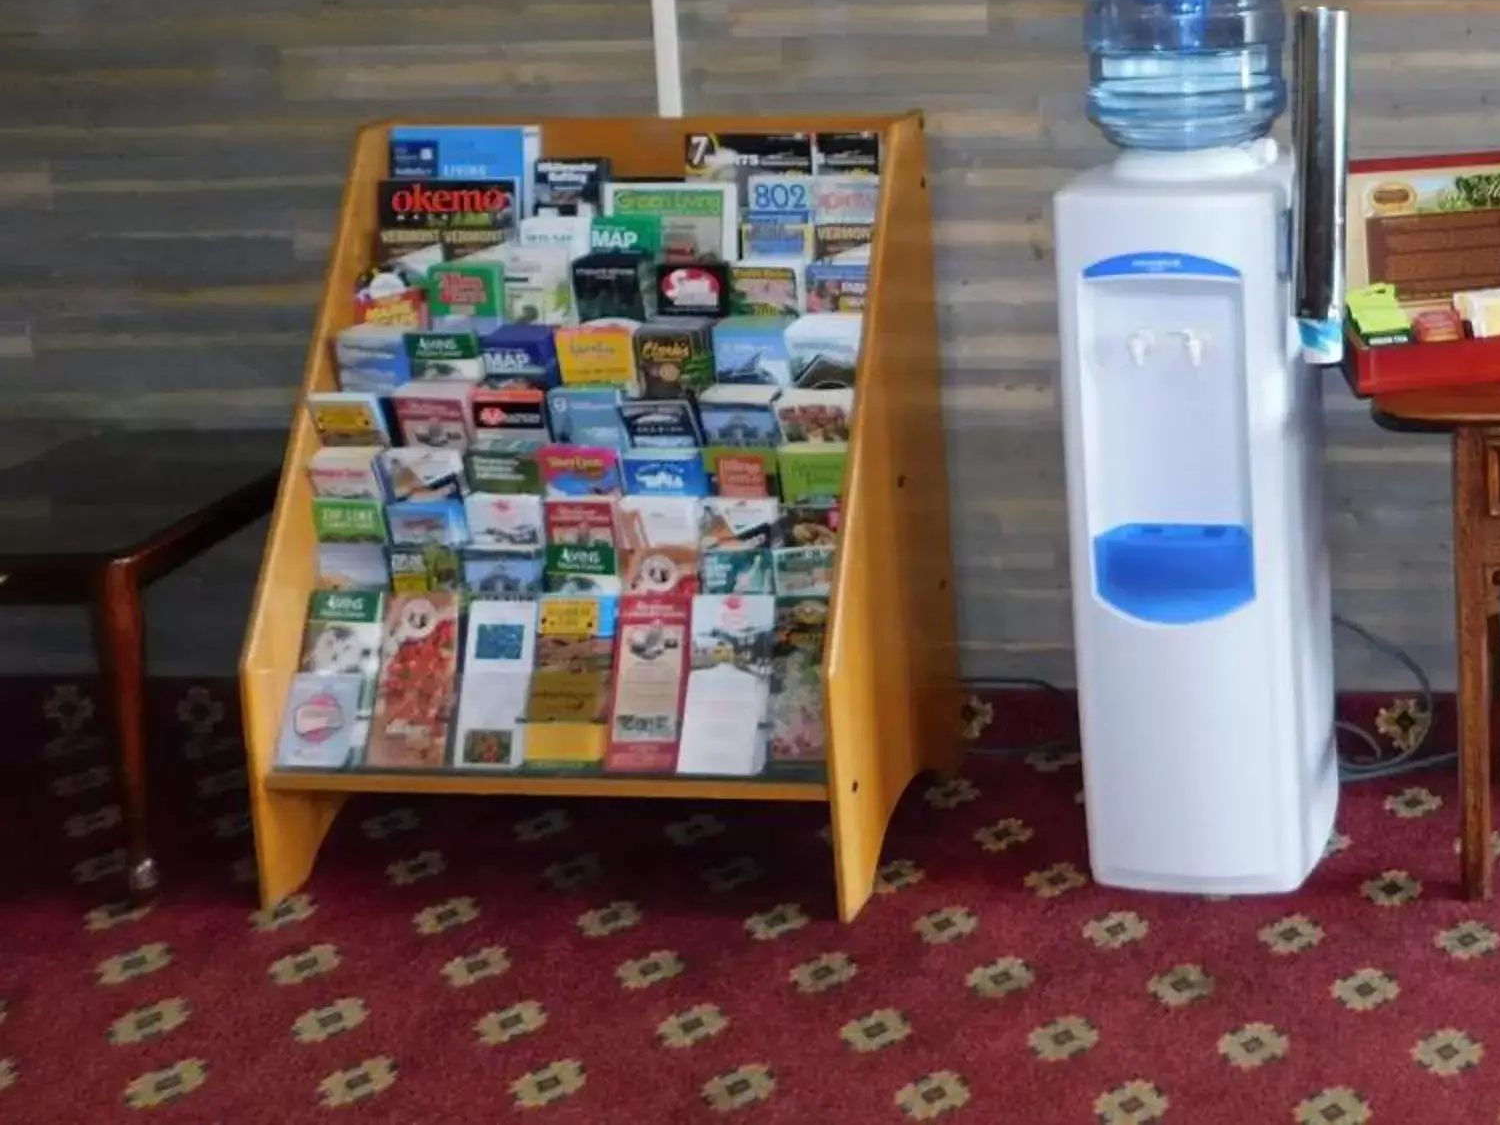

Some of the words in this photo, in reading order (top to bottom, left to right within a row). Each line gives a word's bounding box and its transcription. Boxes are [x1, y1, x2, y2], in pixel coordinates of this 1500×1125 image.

[391, 182, 508, 213] okemo
[754, 183, 807, 209] 802
[592, 230, 639, 248] MAP
[484, 351, 531, 369] MAP
